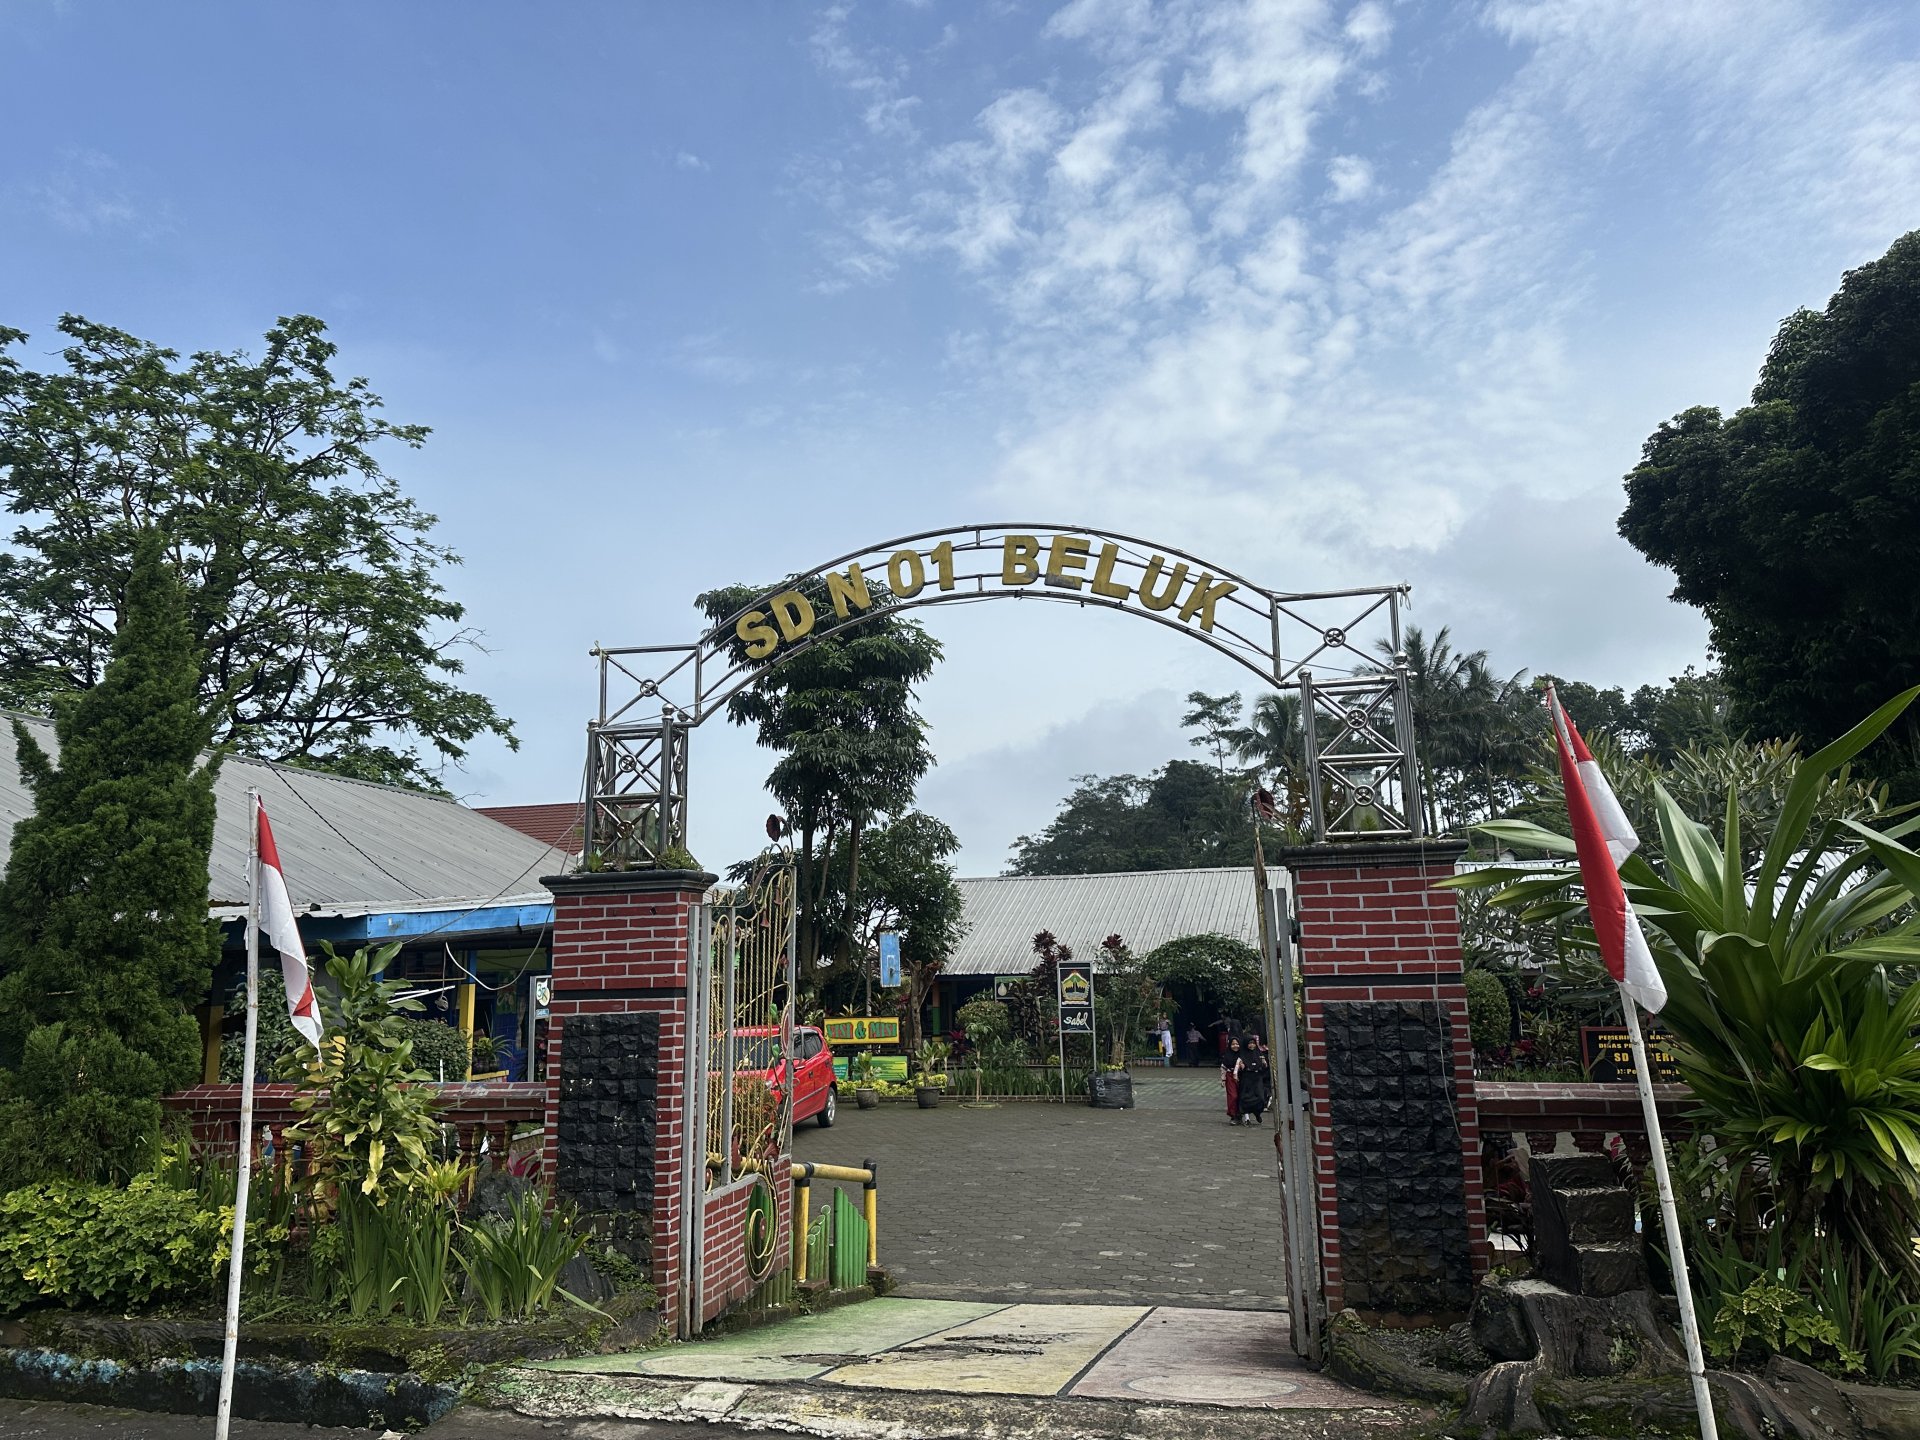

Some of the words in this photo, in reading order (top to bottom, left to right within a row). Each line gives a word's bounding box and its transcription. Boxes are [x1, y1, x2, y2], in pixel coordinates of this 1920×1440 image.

[887, 540, 955, 599] 01
[1002, 534, 1239, 634] BELUK
[826, 1022, 853, 1039] VISI
[855, 1021, 866, 1039] &
[868, 1022, 897, 1039] MISI
[1613, 1052, 1629, 1062] SD
